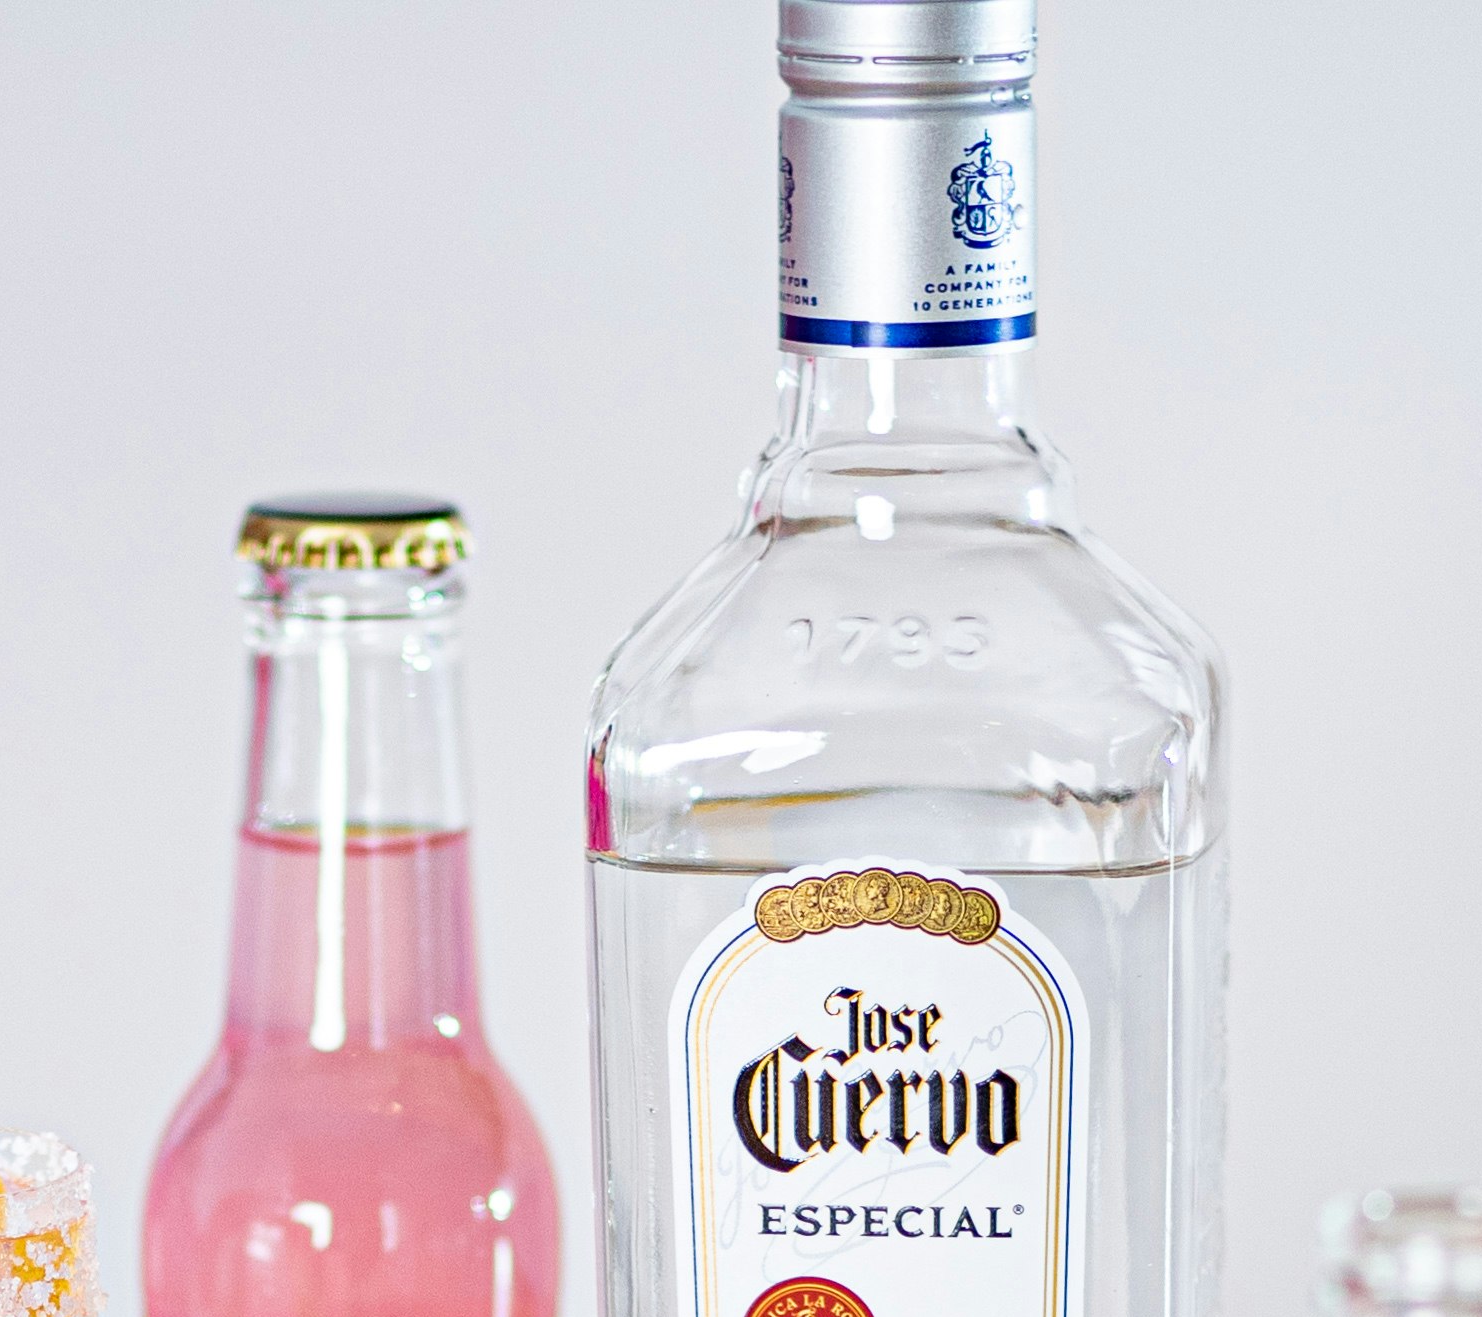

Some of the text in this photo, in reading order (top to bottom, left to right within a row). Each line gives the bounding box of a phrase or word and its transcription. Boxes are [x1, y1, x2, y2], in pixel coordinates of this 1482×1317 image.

[945, 265, 956, 276] A
[924, 280, 1002, 294] COMPANY
[913, 301, 932, 312] 10
[823, 986, 943, 1063] Jose
[732, 1033, 1022, 1174] Cuervo
[803, 1294, 826, 1309] LA
